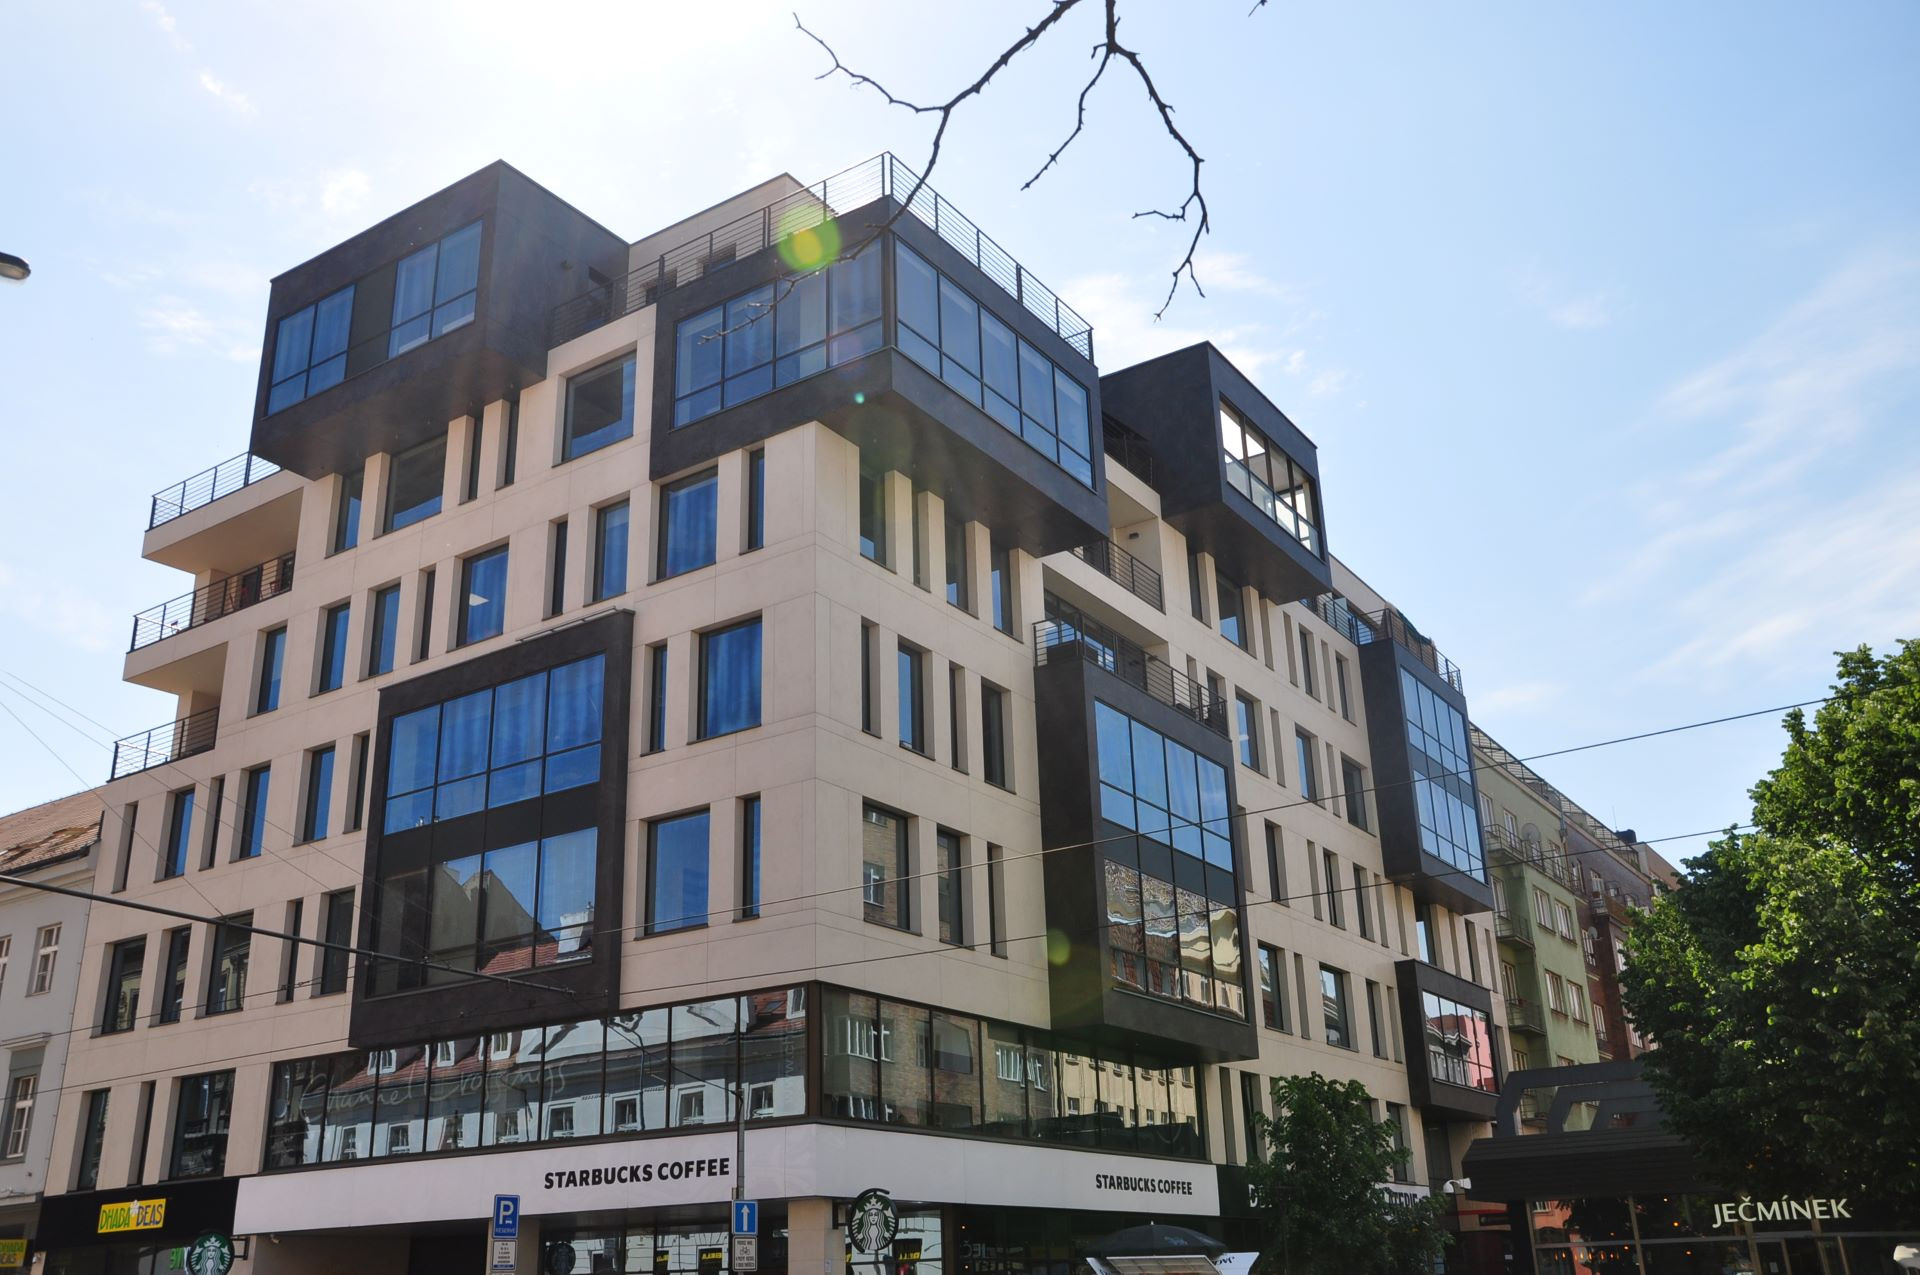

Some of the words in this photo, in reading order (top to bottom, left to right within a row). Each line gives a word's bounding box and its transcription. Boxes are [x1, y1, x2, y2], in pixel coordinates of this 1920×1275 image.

[544, 1164, 653, 1190] STARBUCKS
[657, 1157, 730, 1181] COFFEE
[1095, 1173, 1156, 1193] STARBUCKS
[1157, 1179, 1193, 1196] COFFEE
[99, 1206, 131, 1230] DHABA
[135, 1203, 163, 1227] BEAS
[499, 1200, 514, 1225] P
[1712, 1194, 1852, 1229] JEČMÍNEK
